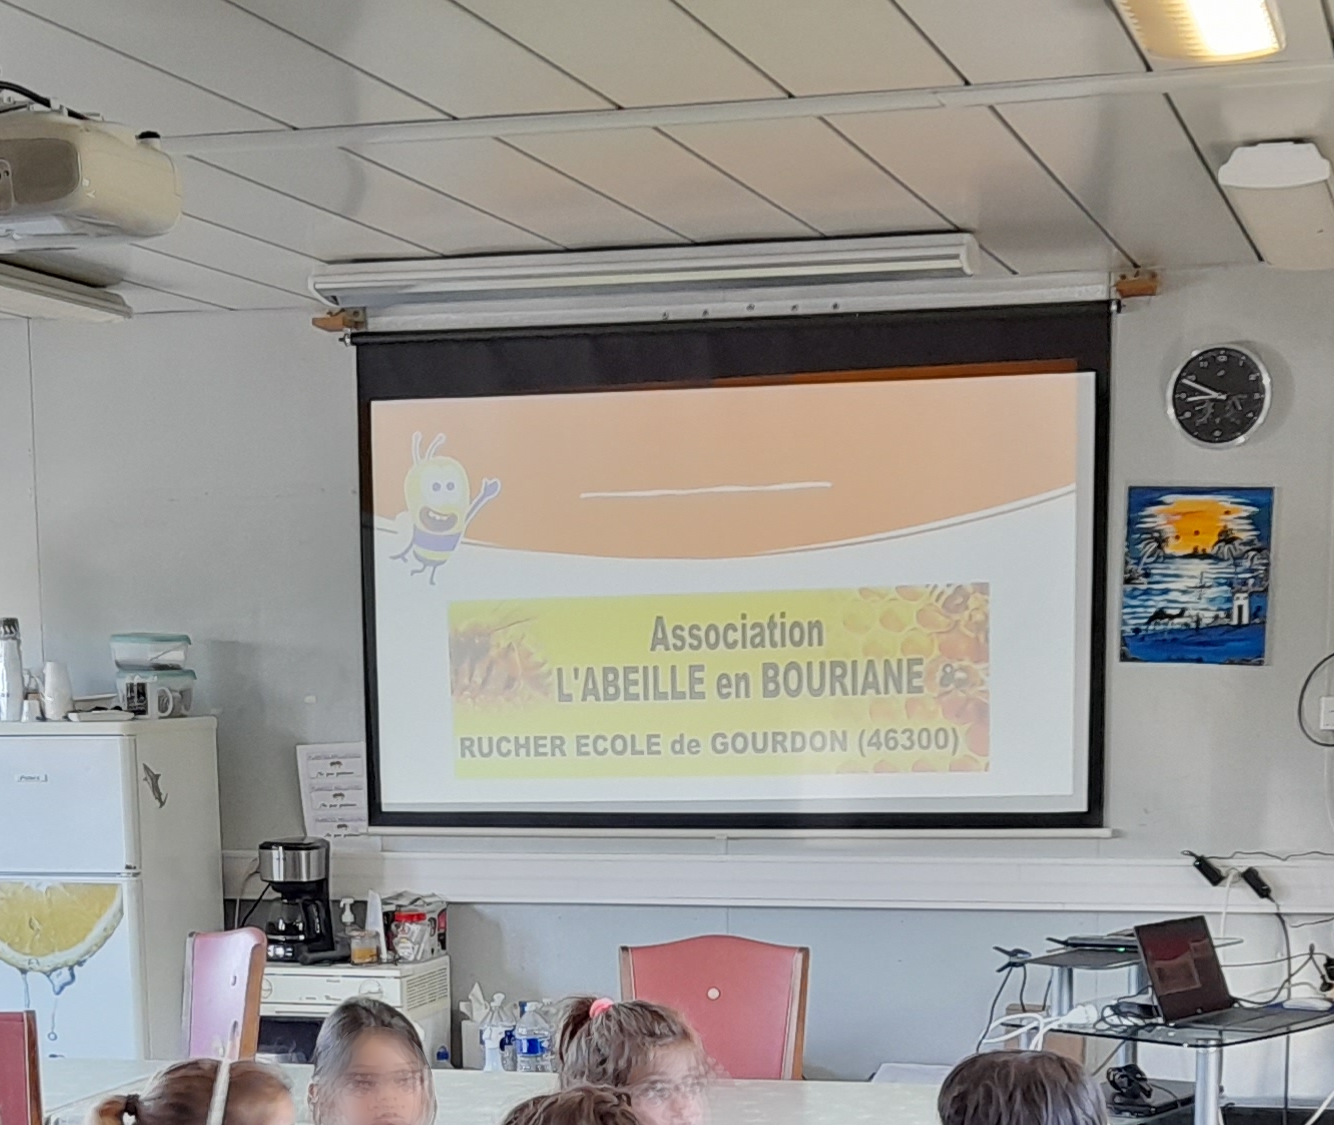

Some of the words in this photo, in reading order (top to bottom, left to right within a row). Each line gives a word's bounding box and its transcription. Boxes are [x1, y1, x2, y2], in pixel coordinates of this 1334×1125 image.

[650, 611, 825, 652] Association
[556, 664, 707, 703] L'ABEILLE
[716, 670, 751, 700] en
[761, 658, 925, 699] BOURIANE
[459, 735, 567, 759] RUCHER
[575, 733, 663, 757] ECOLE
[670, 732, 702, 756] de
[710, 729, 848, 755] GOURDON
[858, 726, 960, 758] (46300)
